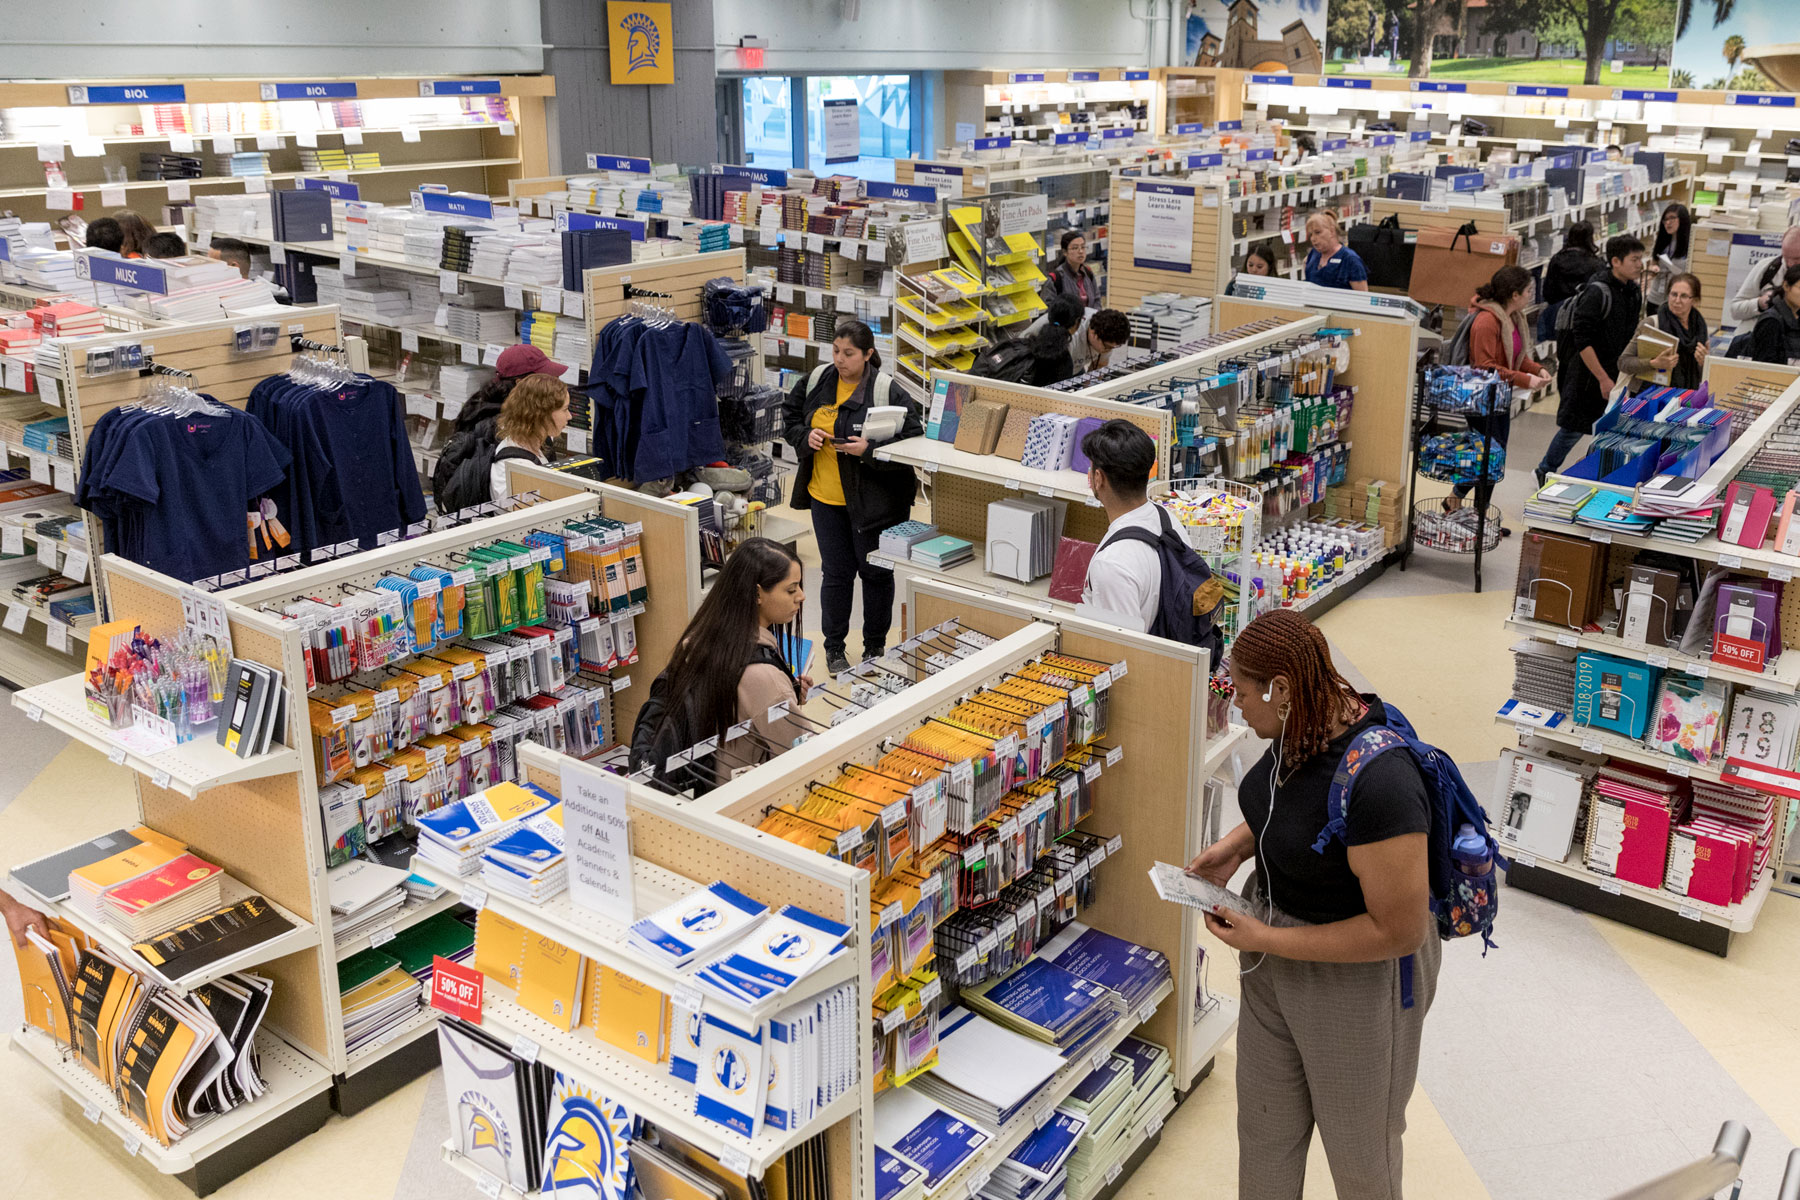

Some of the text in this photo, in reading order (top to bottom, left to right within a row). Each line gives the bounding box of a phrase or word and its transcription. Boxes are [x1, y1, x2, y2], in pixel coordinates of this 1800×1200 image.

[124, 88, 149, 99] BIOL
[306, 86, 327, 96] BIOL
[1643, 92, 1655, 100] BUS
[1758, 97, 1771, 105] BUS
[616, 160, 631, 170] LING
[892, 187, 909, 198] MAS
[448, 202, 466, 212] MATH
[1002, 204, 1043, 220] Fine Art Pads
[908, 235, 921, 246] Fine
[922, 233, 931, 244] Art
[115, 267, 138, 284] MUSC
[1722, 645, 1755, 659] 50% OFF
[1742, 706, 1776, 734] 18
[1737, 733, 1770, 759] 19
[577, 785, 609, 805] Take an
[564, 798, 625, 830] Additional 50%
[581, 824, 610, 842] off ALL
[577, 838, 617, 861] Academic
[576, 854, 620, 880] Planners &
[579, 873, 620, 898] Calendars
[85, 965, 103, 981] RHODIA
[441, 976, 474, 1000] 50% OFF
[999, 983, 1029, 1005] WRITING PADS
[1004, 989, 1031, 1009] BLOC-NOTES
[1010, 1000, 1025, 1010] BLOCS
[1029, 986, 1045, 997] NOTAS
[148, 1015, 166, 1034] RHODIA
